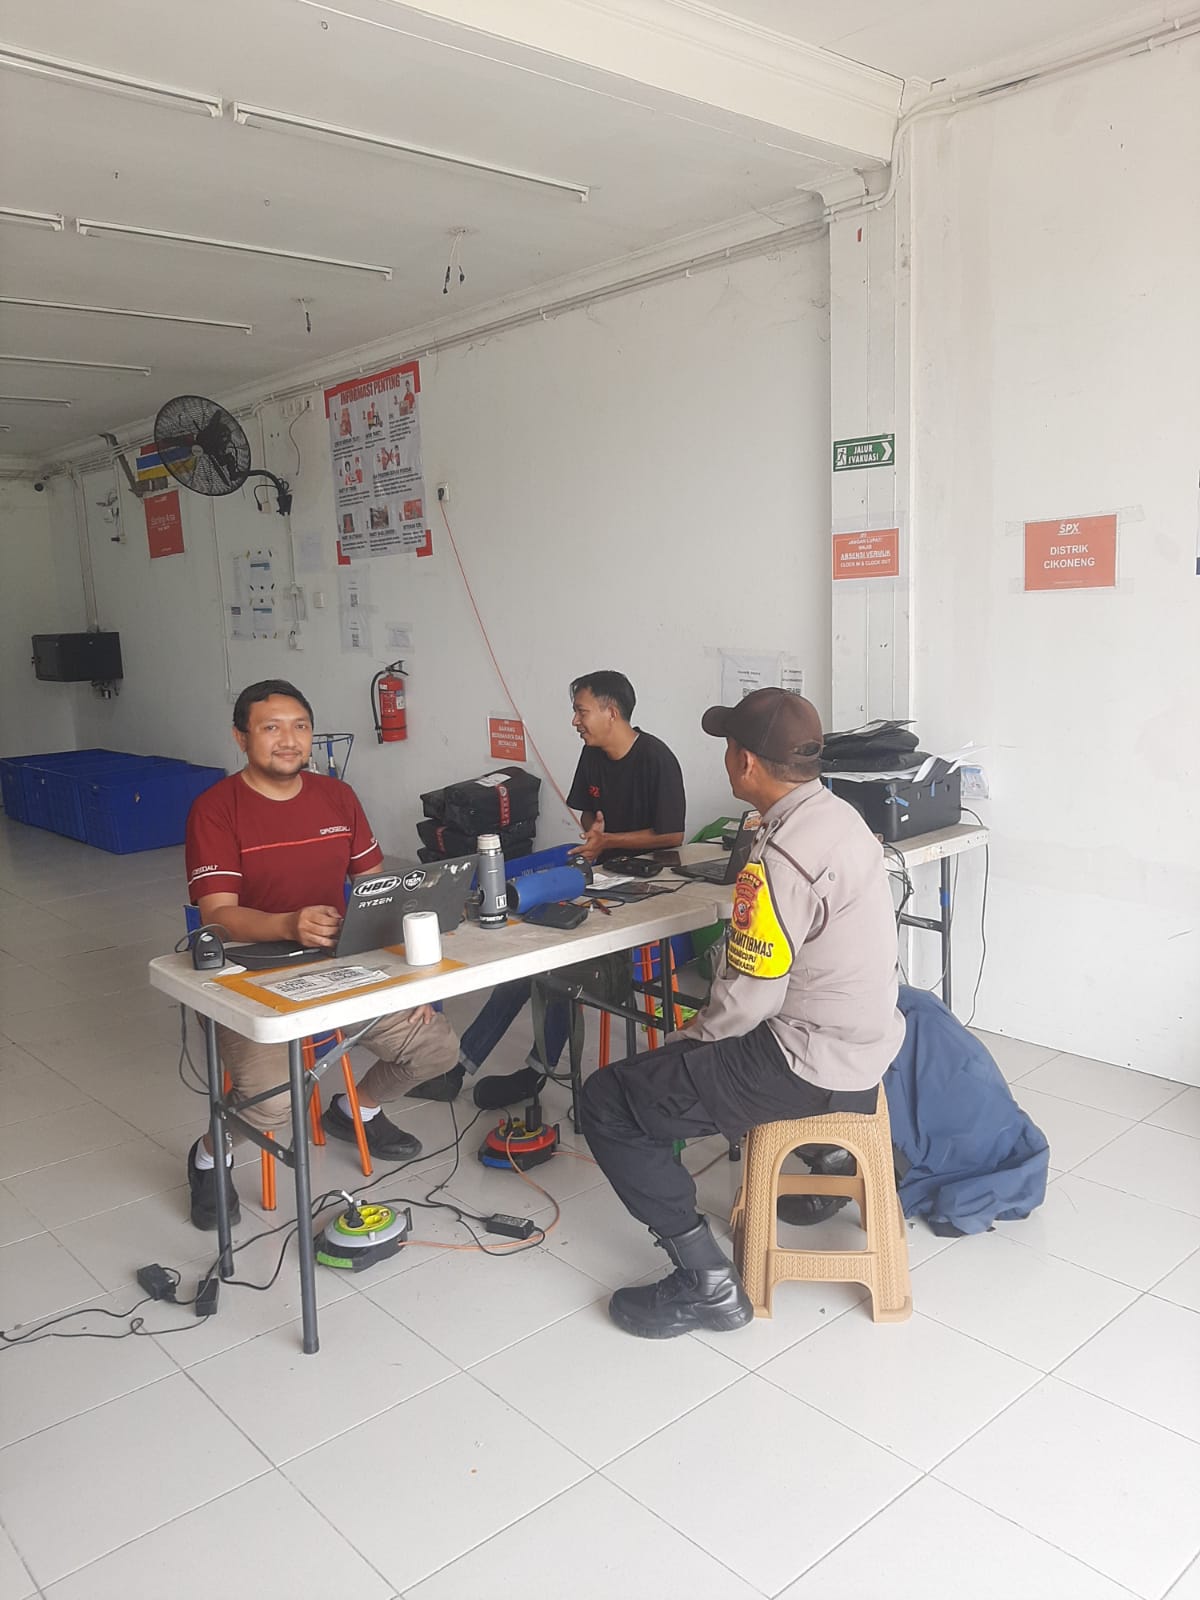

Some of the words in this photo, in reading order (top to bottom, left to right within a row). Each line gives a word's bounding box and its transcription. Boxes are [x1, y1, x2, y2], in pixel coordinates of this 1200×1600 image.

[340, 382, 373, 406] INFORMASI
[374, 374, 401, 395] PENTING
[854, 444, 873, 454] JALUR
[848, 453, 879, 465] EVAKUASI
[1058, 522, 1080, 535] SPX
[1049, 543, 1089, 556] DISTRIK
[1043, 557, 1096, 569] CIKONENG
[359, 897, 392, 908] RYZEN
